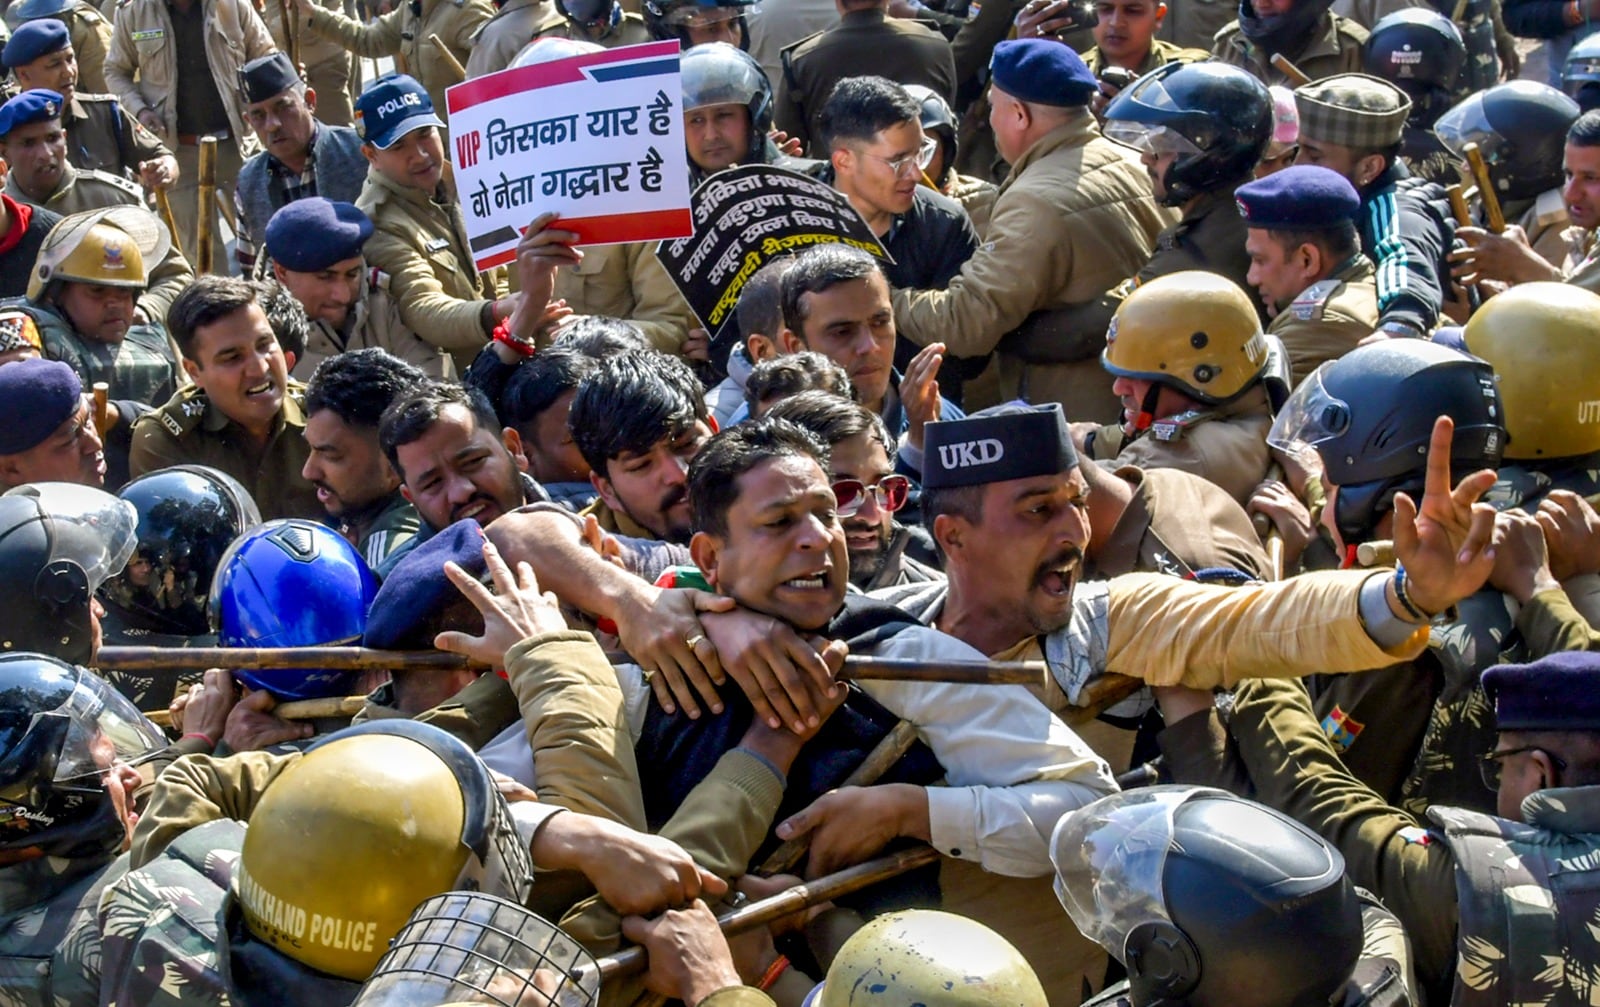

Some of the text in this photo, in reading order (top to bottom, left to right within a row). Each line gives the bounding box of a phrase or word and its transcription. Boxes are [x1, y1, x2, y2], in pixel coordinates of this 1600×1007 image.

[377, 92, 421, 119] POLICE
[456, 90, 673, 170] VIP जिसका यार है
[470, 179, 491, 218] वो
[493, 172, 535, 210] नेता
[637, 146, 664, 192] है
[694, 174, 762, 224] अंकिता
[680, 227, 719, 283] ममता
[707, 238, 743, 286] सबूत
[740, 214, 791, 244] खत्म
[937, 438, 1004, 470] UKD
[309, 913, 377, 952] POLICE
